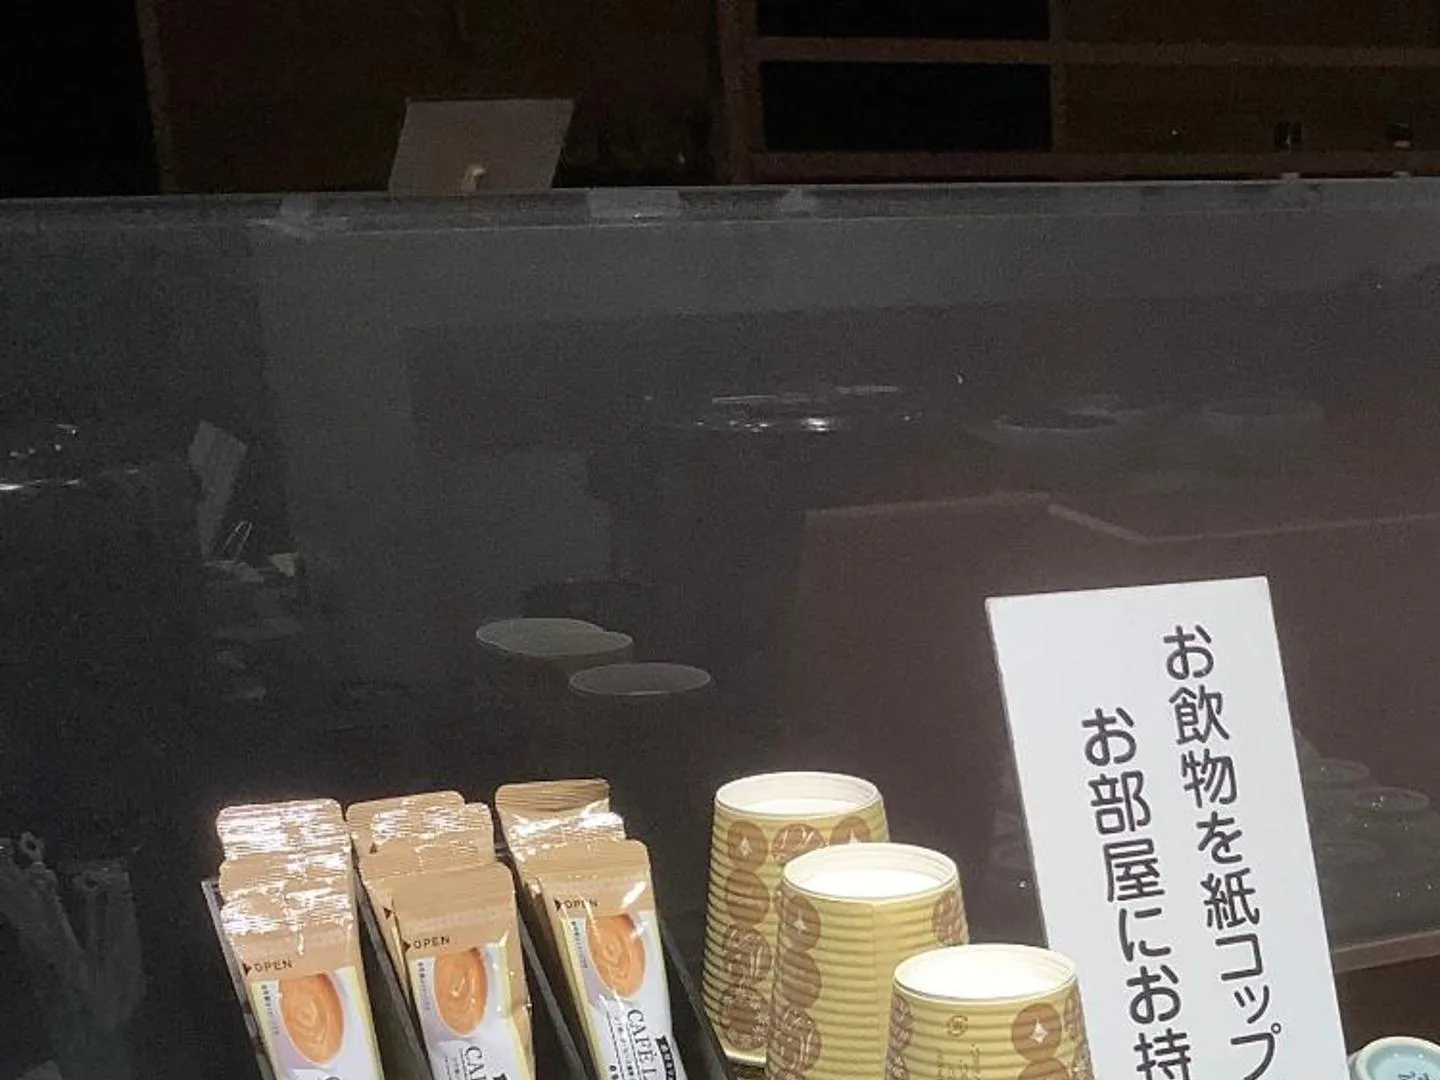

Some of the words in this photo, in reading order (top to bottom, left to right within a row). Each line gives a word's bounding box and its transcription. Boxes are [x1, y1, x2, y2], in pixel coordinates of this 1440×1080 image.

[564, 899, 599, 910] OPEN
[412, 935, 450, 950] OPEN
[254, 959, 293, 973] OPEN
